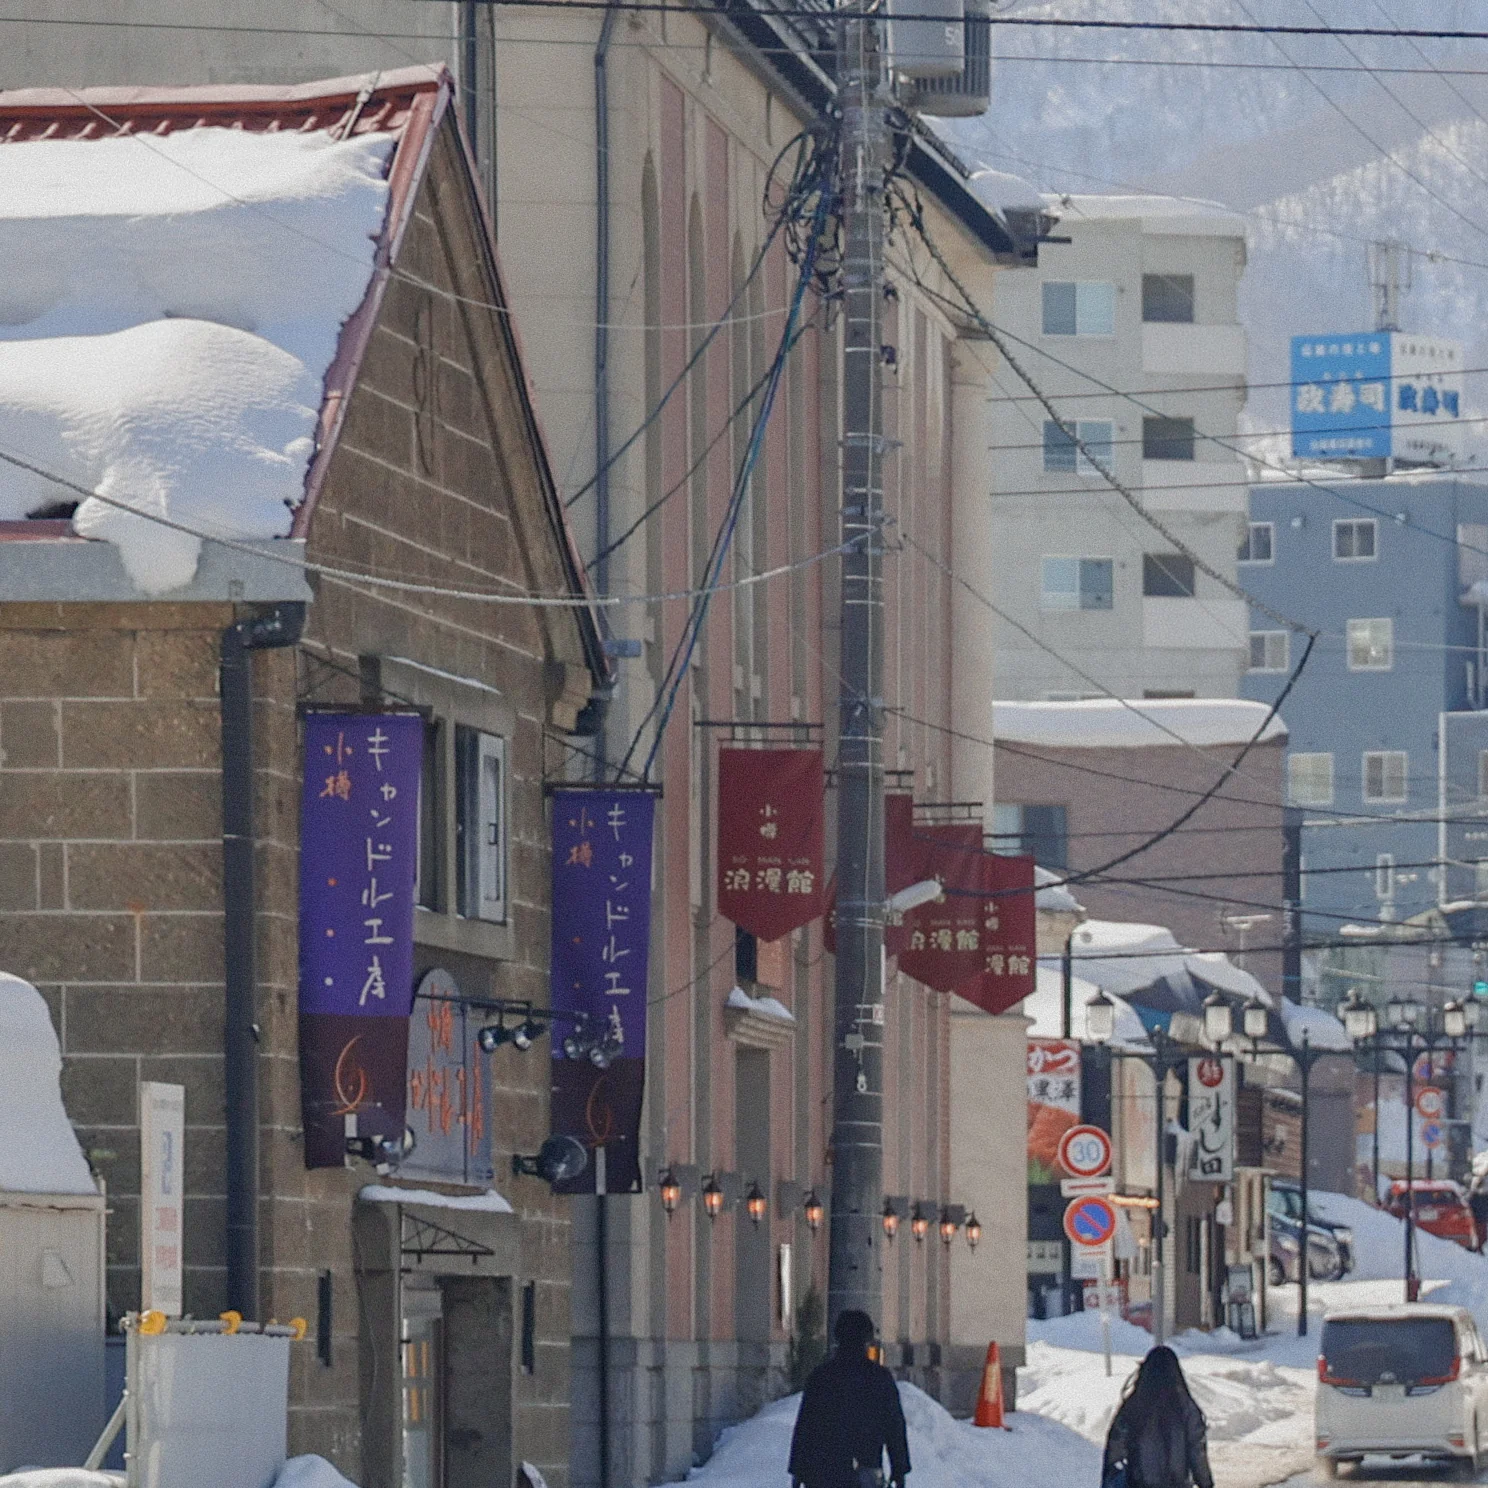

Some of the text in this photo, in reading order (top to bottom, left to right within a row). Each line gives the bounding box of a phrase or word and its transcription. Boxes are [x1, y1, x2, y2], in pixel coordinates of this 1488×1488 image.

[317, 731, 353, 801] 小樽
[358, 726, 396, 1005] キャンドル工房
[565, 806, 596, 868] 小樽
[724, 867, 815, 894] 浪漫館
[1072, 1140, 1100, 1163] 30
